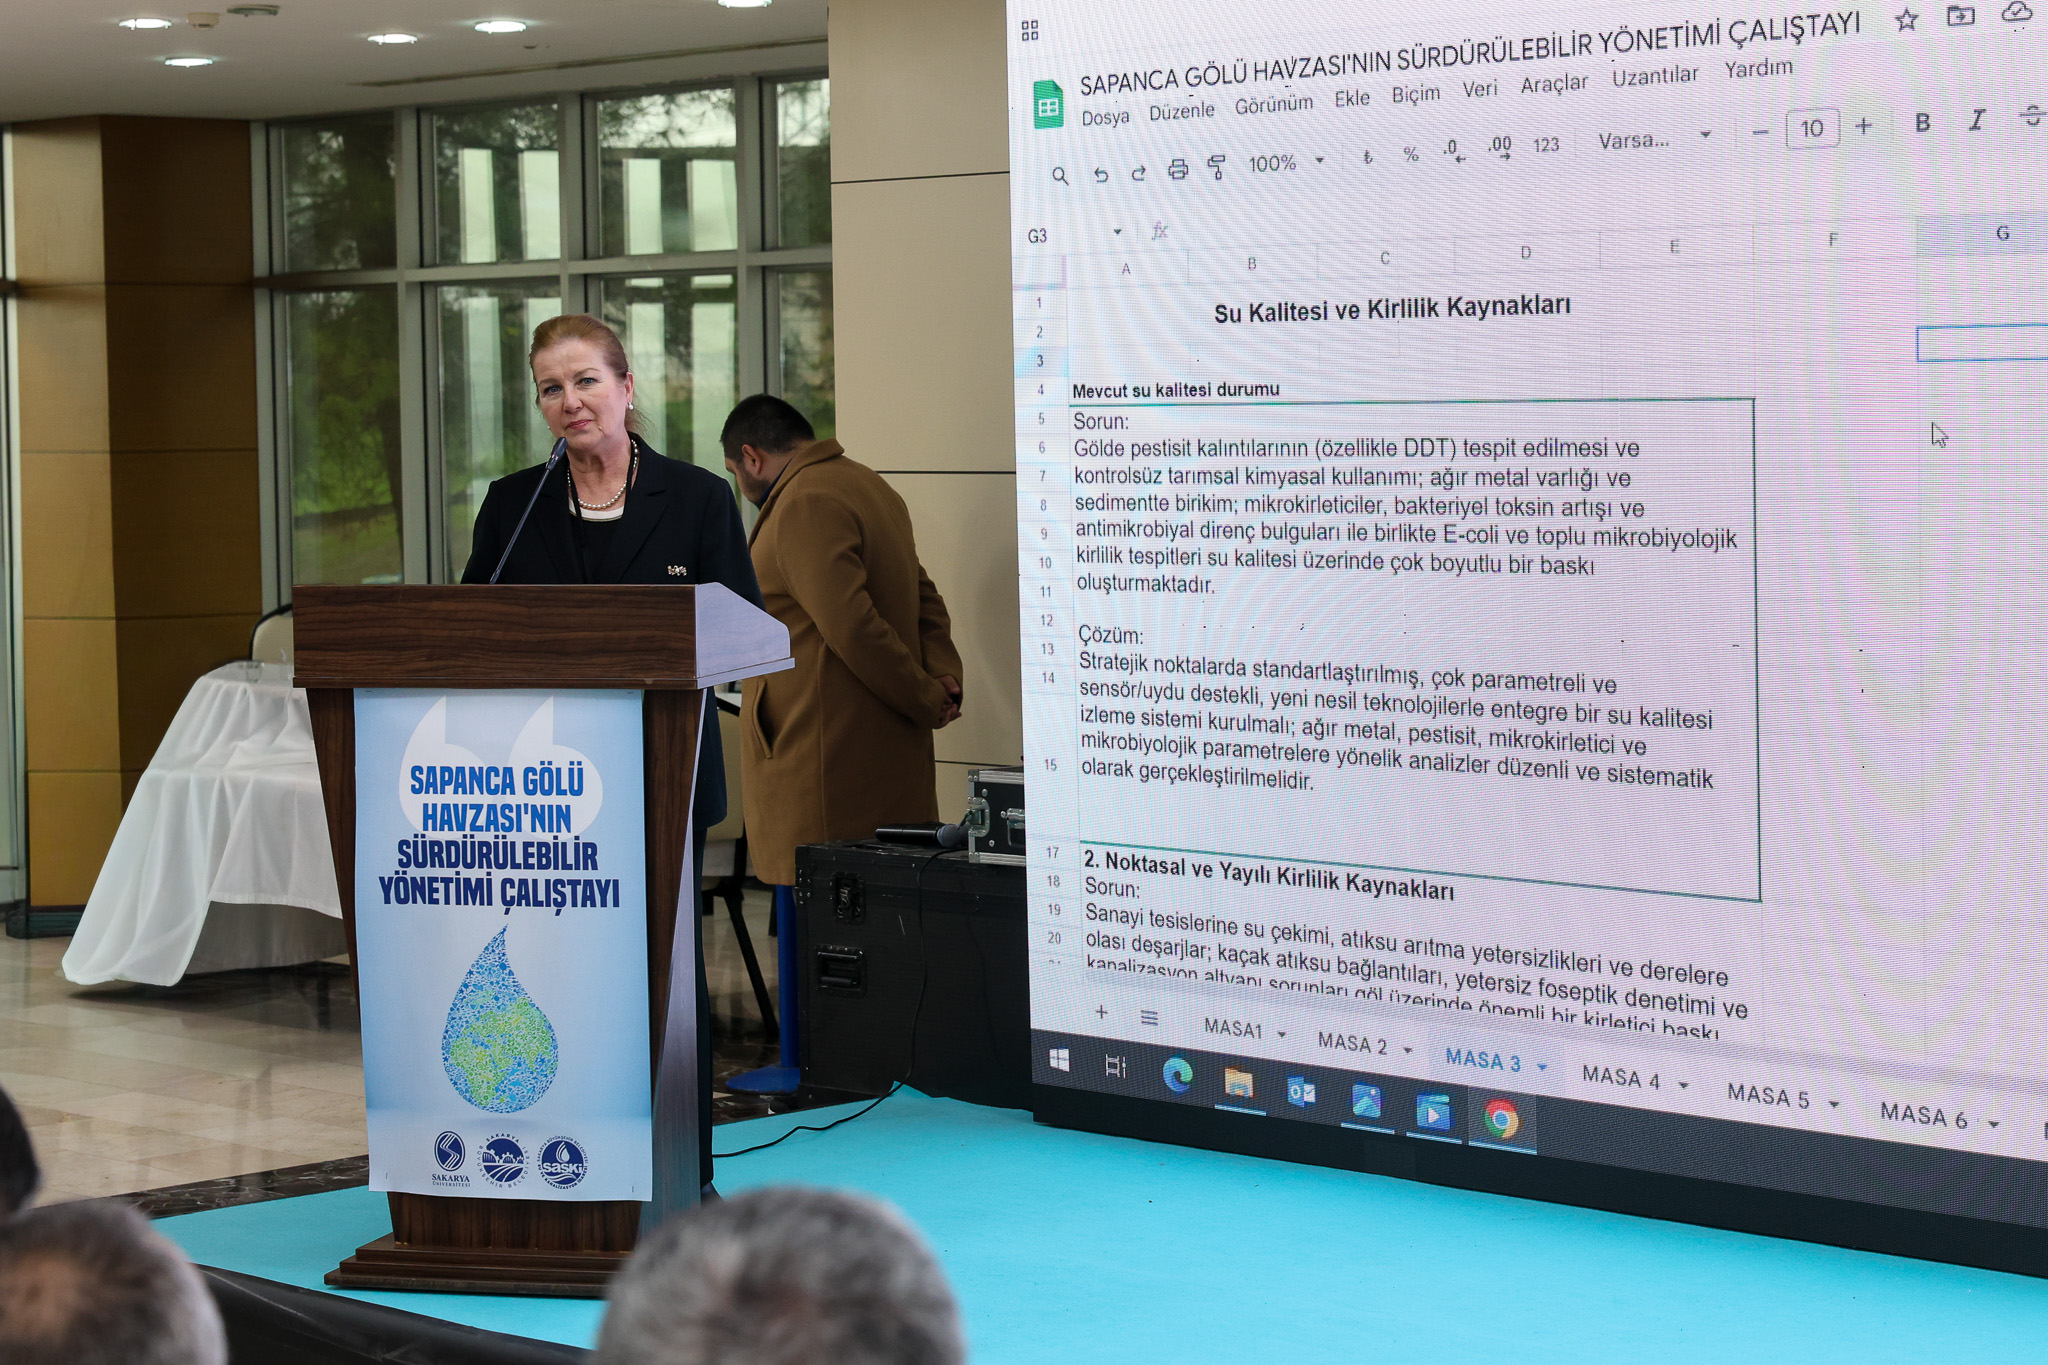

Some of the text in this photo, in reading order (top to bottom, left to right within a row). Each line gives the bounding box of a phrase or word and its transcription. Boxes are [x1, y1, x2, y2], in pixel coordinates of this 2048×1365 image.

[1081, 11, 1859, 96] SAPANCA GÖLÜ HAVZASI'NIN SÜRDÜRÜLEBİLİR YÖNETİMİ ÇALIŞTAYI
[1082, 58, 1793, 127] Dosya Düzenle Görünüm Ekle Biçim Veri Araçlar Uzantılar Yardım
[1249, 154, 1296, 172] 100%
[1534, 138, 1559, 152] 123
[1801, 119, 1823, 137] 10
[1215, 295, 1571, 323] Su Kalitesi ve Kirlilik Kaynakları
[1073, 382, 1279, 398] Mevcut su kalitesi durumu
[1074, 413, 1129, 429] Sorun:
[1075, 438, 1639, 461] Gölde pestisit kalıntılarının (özellikle DDT) tespit edilmesi ve
[1075, 466, 1630, 490] kontrolsüz tarımsal kimyasal kullanımı; ağır metal varlığı ve
[1075, 494, 1644, 521] sedimentte birikim; mikrokirleticiler, bakteriyel toksin artışı ve
[1076, 521, 1738, 553] antimikrobiyal direnç bulguları ile birlikte E-coli ve toplu mikrobiyolojik
[1077, 546, 1594, 577] kirlilik tespitleri su kalitesi üzerinde çok boyutlu bir baskı
[1077, 574, 1214, 595] oluşturmaktadır.
[1079, 625, 1143, 647] Çözüm:
[1080, 652, 1617, 694] Stratejik noktalarda standartlaştırılmış, çok parametreli ve
[1080, 680, 1712, 729] sensör/uydu destekli, yeni nesil teknolojilerle entegre bir su kalitesi
[1081, 706, 1646, 756] izleme sistemi kurulmalı; ağır metal, pestisit, mikrokirletici ve
[1081, 732, 1713, 788] mikrobiyolojik parametrelere yönelik analizler düzenli ve sistematik
[411, 761, 583, 796] SAPANCA GÖLÜ
[1082, 760, 1313, 791] olarak gerçekleştirilmelidir.
[423, 803, 571, 833] HAVZASI'NIN
[398, 834, 598, 871] SÜRDÜRÜLEBİLİR
[1085, 851, 1454, 900] 2. Noktasal ve Yayılı Kirlilik Kaynakları
[1085, 876, 1140, 899] Sorun:
[379, 870, 619, 916] YÖNETİMİ ÇALIŞTAYI
[1086, 903, 1728, 987] Sanayi tesislerine su çekimi, atıksu arıtma yetersizlikleri ve derelere
[1086, 932, 1748, 1019] olası deşarjlar; kaçak atıksu bağlantıları, yetersiz foseptik denetimi ve
[1319, 1032, 1387, 1054] MASA 2
[1446, 1047, 1520, 1071] MASA 3
[1583, 1064, 1660, 1090] MASA 4
[1728, 1083, 1809, 1109] MASA 5
[1882, 1102, 1967, 1129] MASA 6
[486, 1133, 519, 1143] SAKARYA
[432, 1174, 470, 1182] SAKARYA
